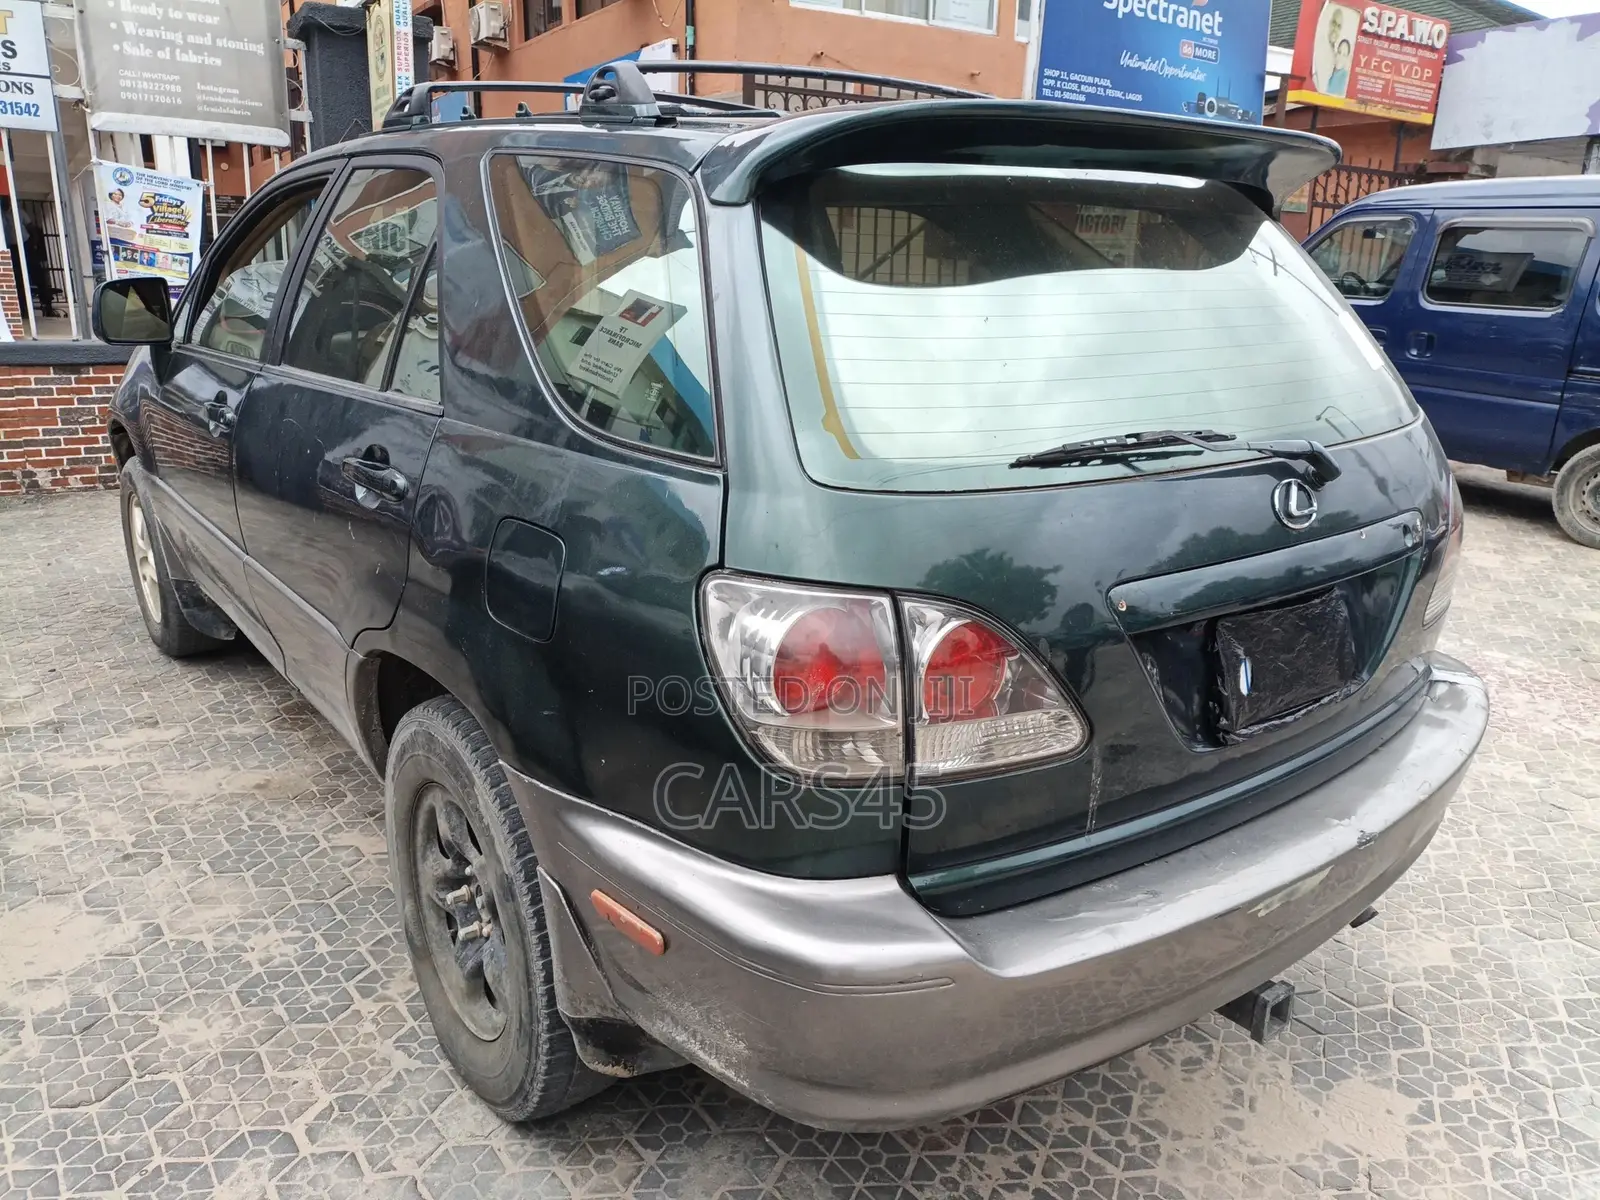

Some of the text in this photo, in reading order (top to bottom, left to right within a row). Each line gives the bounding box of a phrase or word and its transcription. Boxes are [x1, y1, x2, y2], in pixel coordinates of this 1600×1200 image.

[168, 8, 183, 19] to
[186, 11, 220, 25] wear
[121, 20, 265, 56] Weaving and stoning
[122, 41, 222, 67] Sale of fabrics
[1120, 50, 1160, 72] Unlimited
[1194, 47, 1217, 61] MORE
[118, 69, 136, 78] CALL
[141, 71, 180, 82] WHATSAPP
[1043, 68, 1060, 78] SHOP
[196, 82, 240, 94] Instagram
[1125, 92, 1143, 102] LAGOS
[0, 101, 41, 118] 31542
[138, 192, 156, 208] 5
[152, 203, 183, 214] Village
